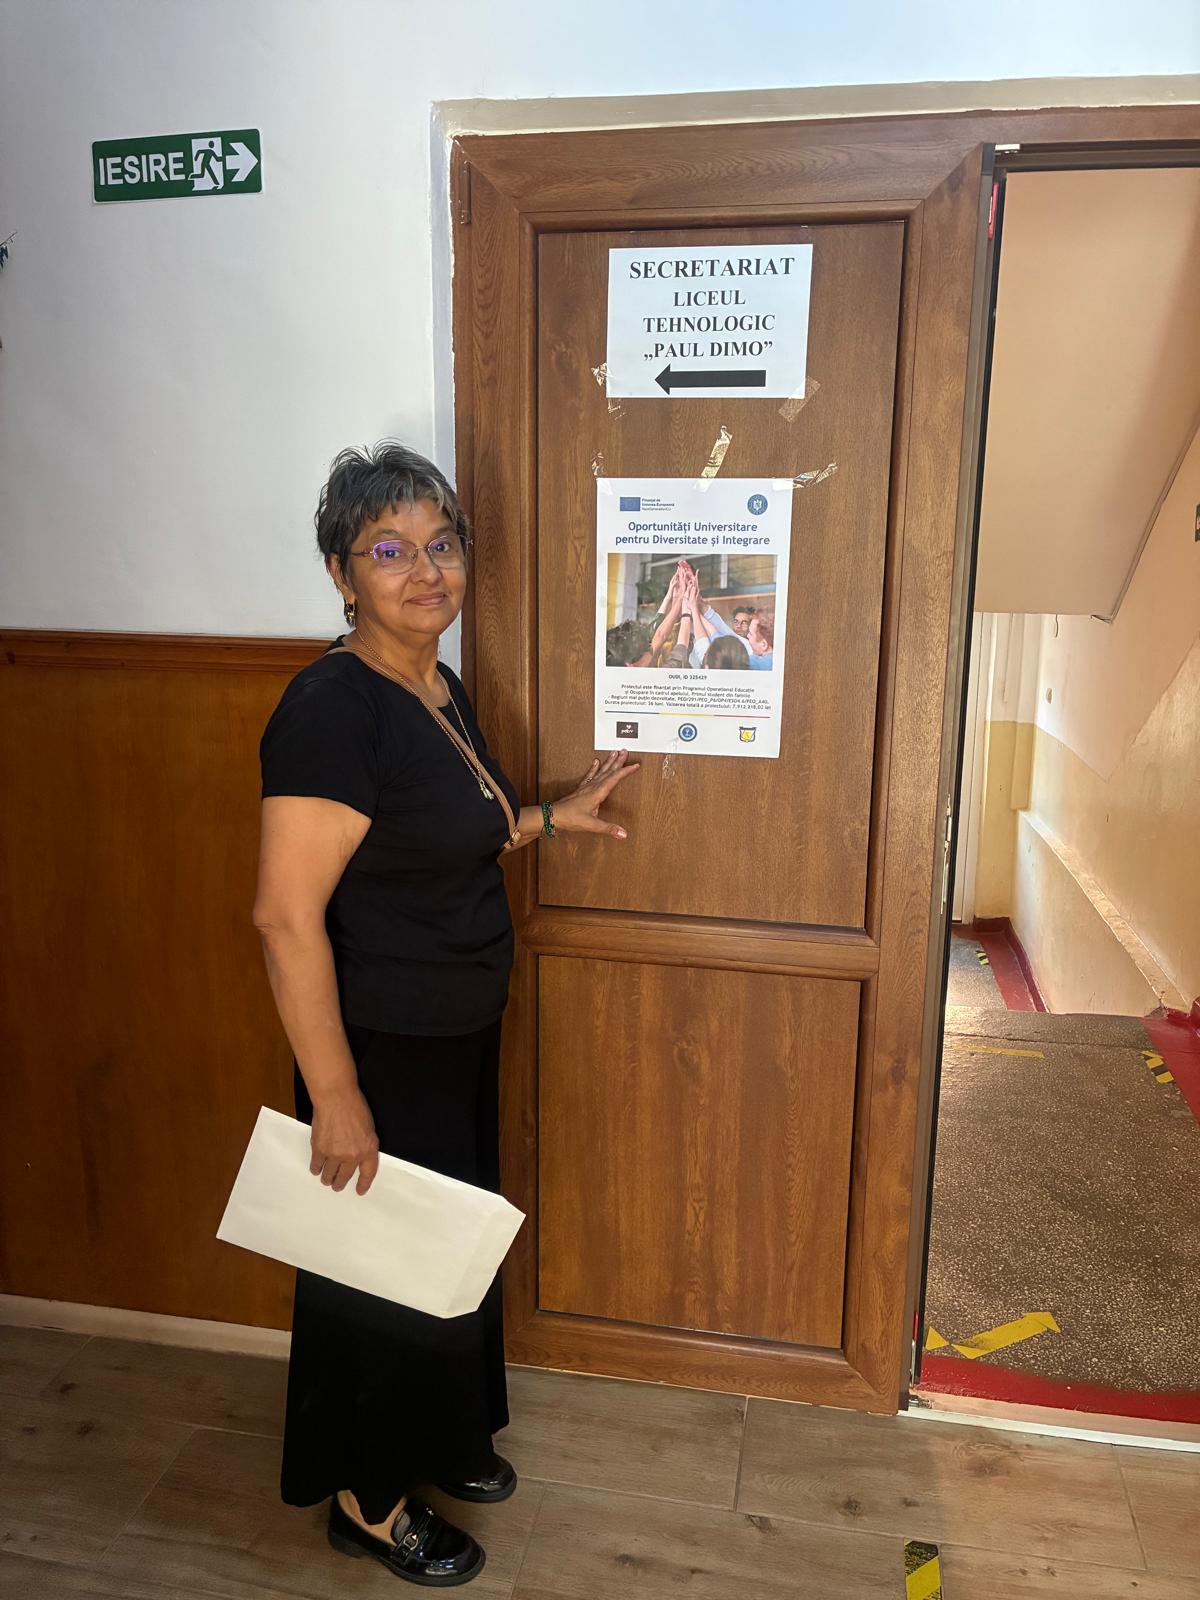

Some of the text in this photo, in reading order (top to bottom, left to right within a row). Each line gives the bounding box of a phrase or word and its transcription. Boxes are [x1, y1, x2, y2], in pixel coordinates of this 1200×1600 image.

[99, 152, 185, 185] IESIRE
[629, 258, 795, 279] SECRETARIAT
[674, 290, 746, 307] LICEUL
[643, 315, 776, 333] TEHNOLOGIC
[644, 341, 773, 361] „PAUL DIMO”
[628, 522, 758, 533] Oportunități Universitare
[615, 535, 770, 547] pentru Diversitate și Integrare
